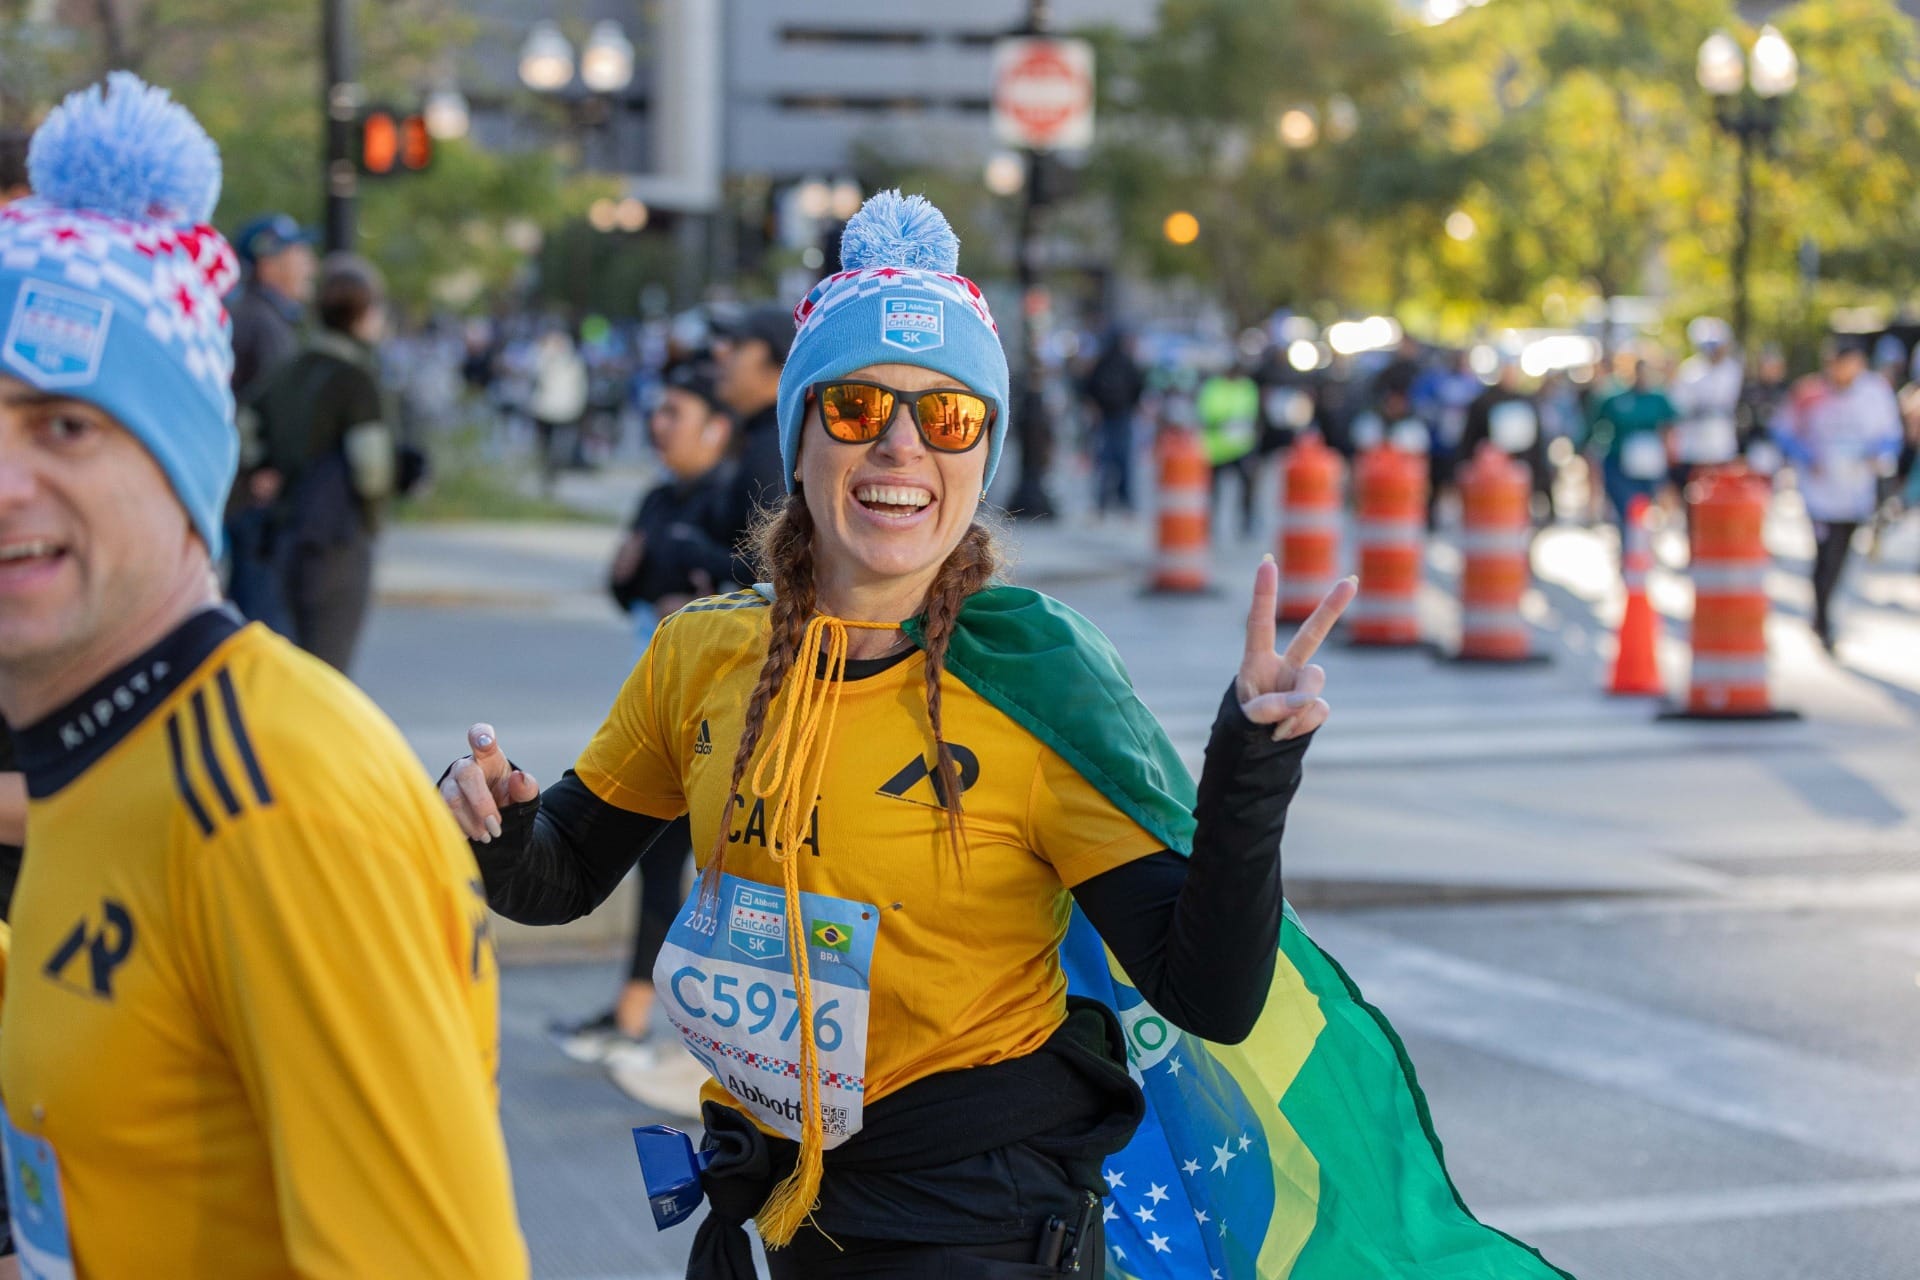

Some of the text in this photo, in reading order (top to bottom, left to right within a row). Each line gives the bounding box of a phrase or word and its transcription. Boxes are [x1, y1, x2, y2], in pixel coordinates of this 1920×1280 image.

[888, 320, 936, 329] CHICAGO
[902, 331, 921, 344] 5K
[754, 897, 779, 909] Abbott
[683, 910, 718, 937] 2023
[734, 917, 781, 935] CHICAGO
[748, 937, 767, 953] 5K
[820, 951, 840, 964] BRA
[670, 965, 843, 1052] C5976
[728, 1073, 804, 1125] Abbott
